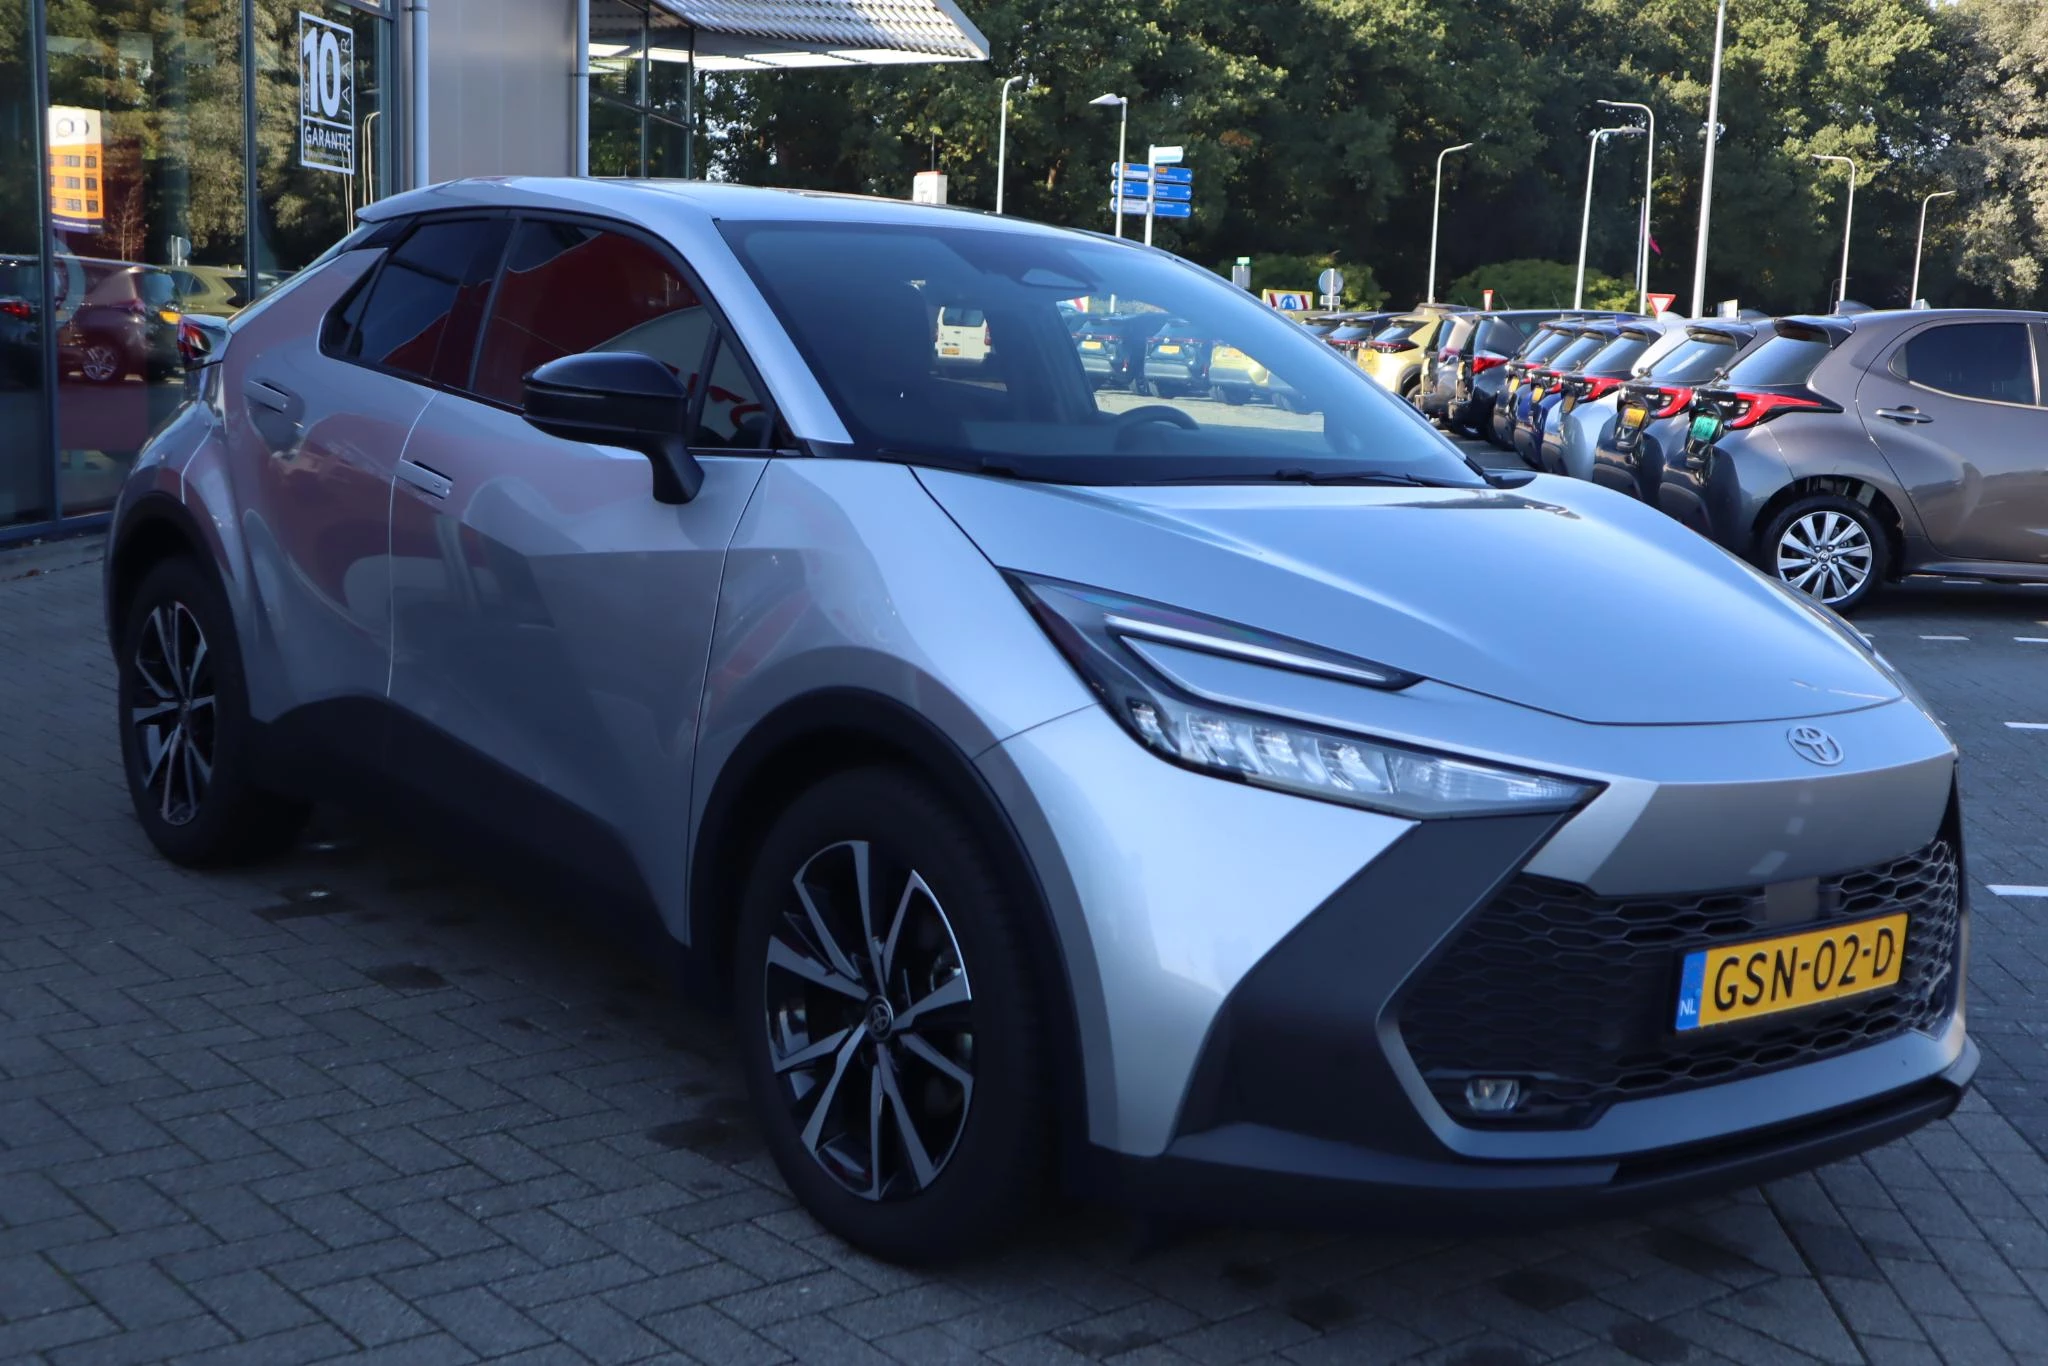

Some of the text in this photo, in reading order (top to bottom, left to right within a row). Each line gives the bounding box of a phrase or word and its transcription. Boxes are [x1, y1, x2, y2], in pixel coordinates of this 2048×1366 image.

[303, 27, 341, 118] 10
[341, 38, 351, 121] JAAR
[304, 125, 351, 152] GARANTIE
[1680, 999, 1697, 1017] NL
[1714, 927, 1896, 1012] GSN-02-D
